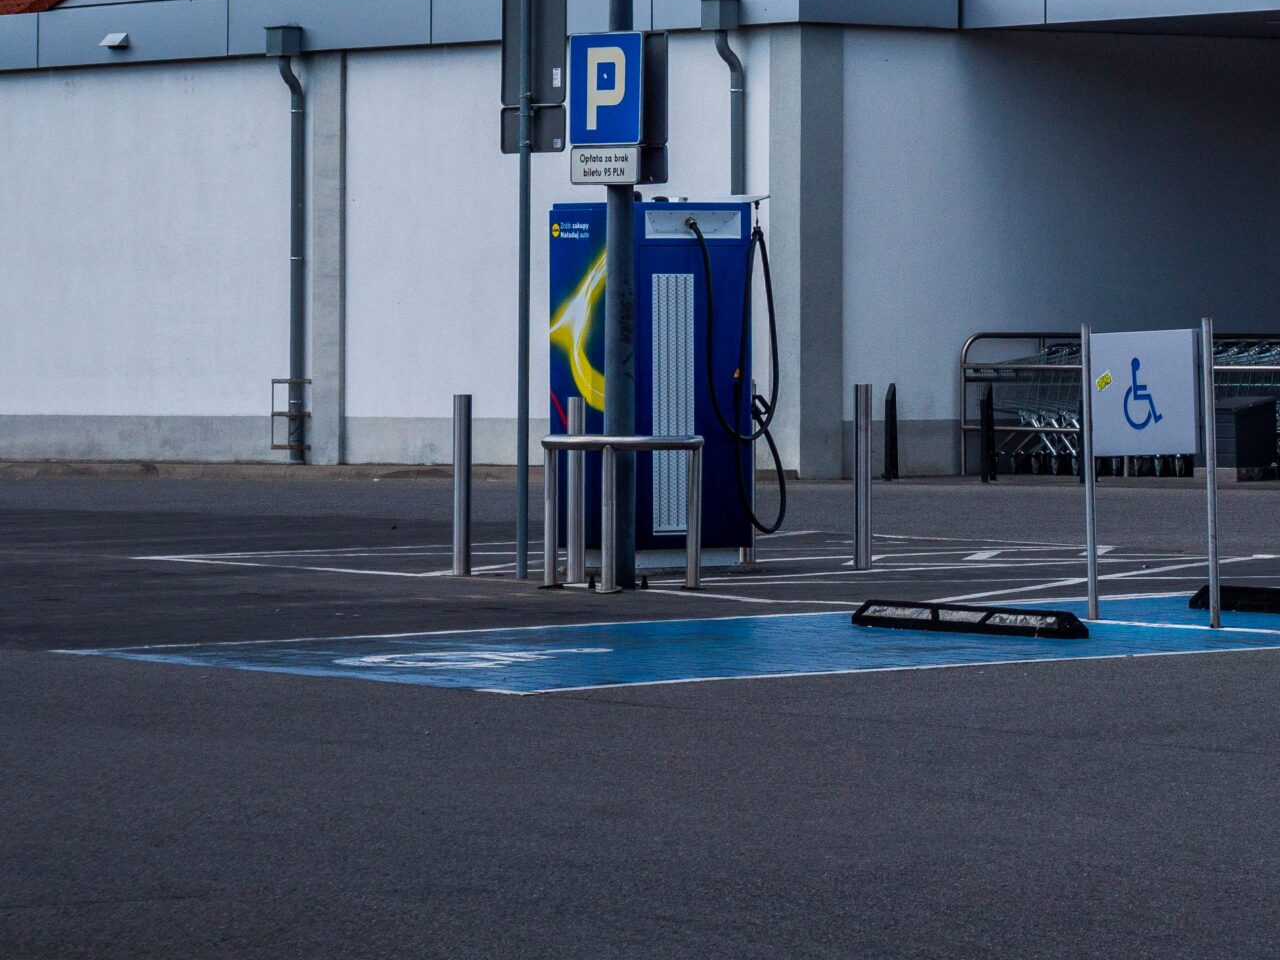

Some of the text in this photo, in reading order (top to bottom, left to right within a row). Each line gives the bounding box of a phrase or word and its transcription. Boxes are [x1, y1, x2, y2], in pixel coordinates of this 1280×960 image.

[586, 47, 626, 131] P
[579, 153, 629, 165] Opłata za brak
[583, 168, 626, 178] biletu 95 PLN
